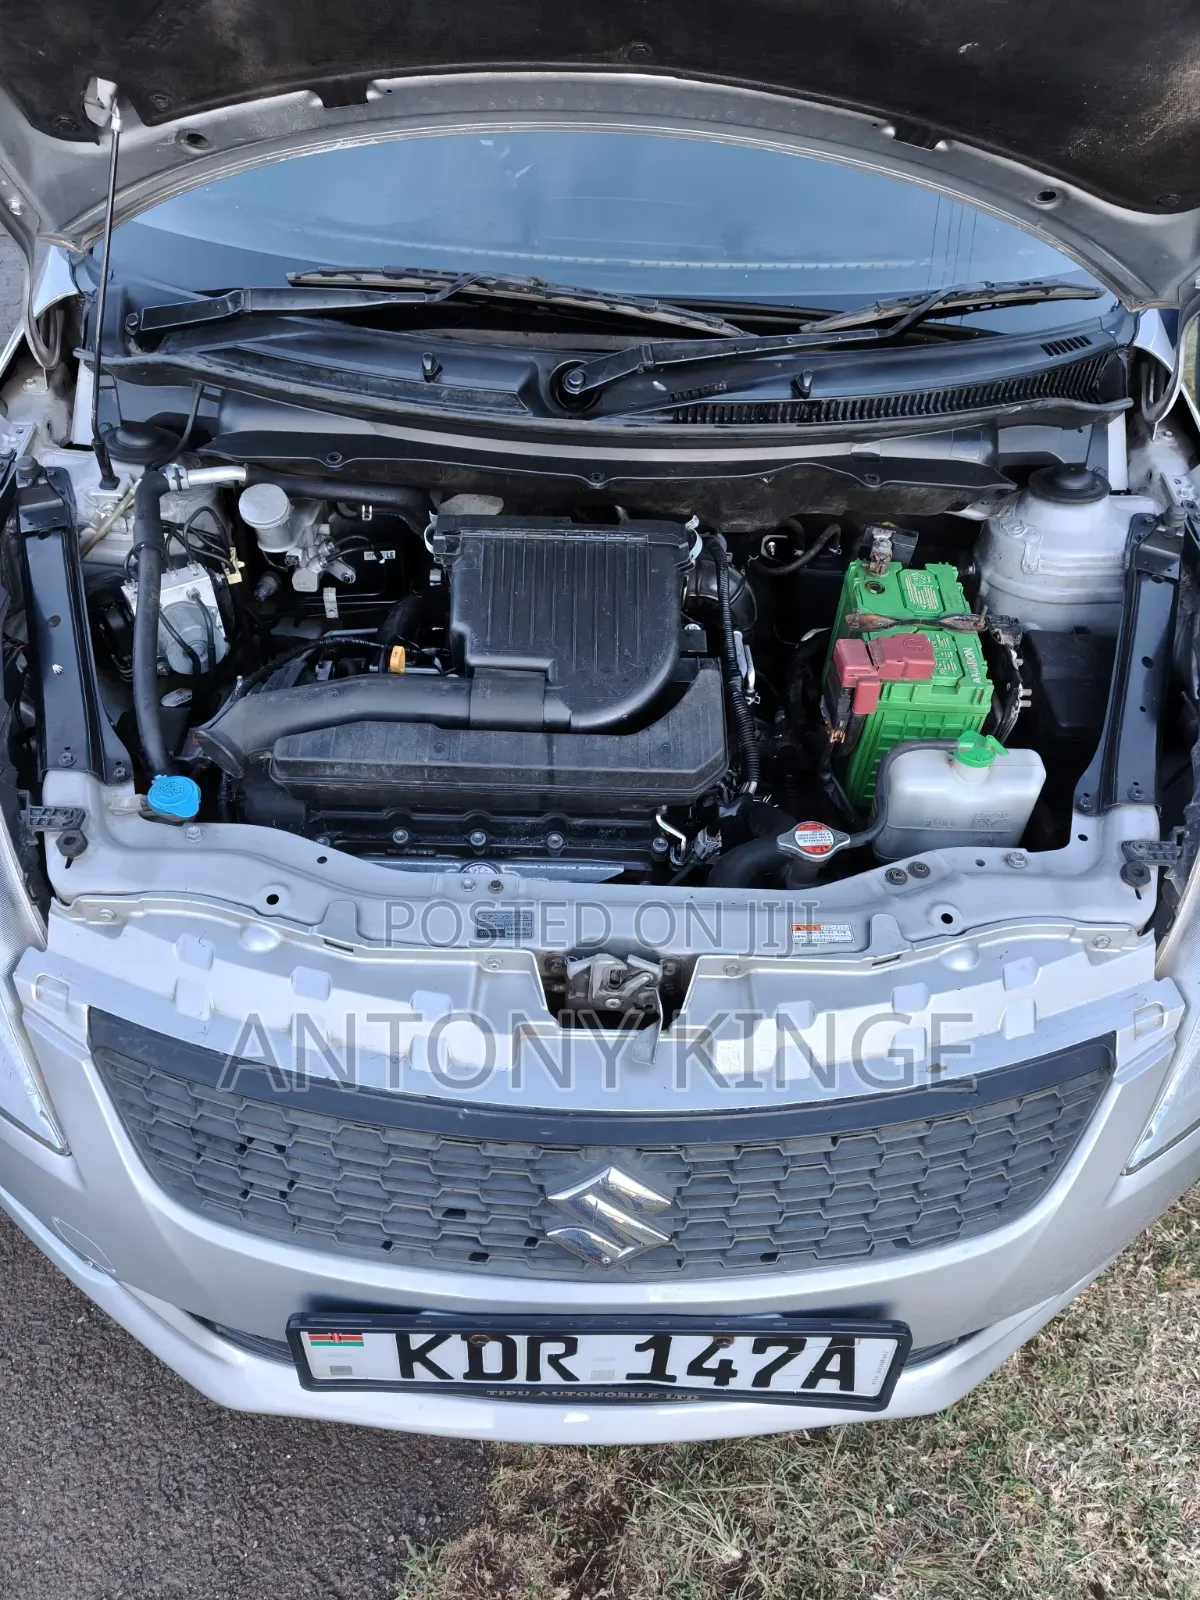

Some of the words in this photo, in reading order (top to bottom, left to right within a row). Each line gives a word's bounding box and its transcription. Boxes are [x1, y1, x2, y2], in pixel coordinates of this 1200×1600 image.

[396, 1332, 579, 1382] KDR
[626, 1335, 855, 1390] 147A
[538, 1390, 659, 1399] AUTOMOBILE
[665, 1393, 700, 1401] LTD
